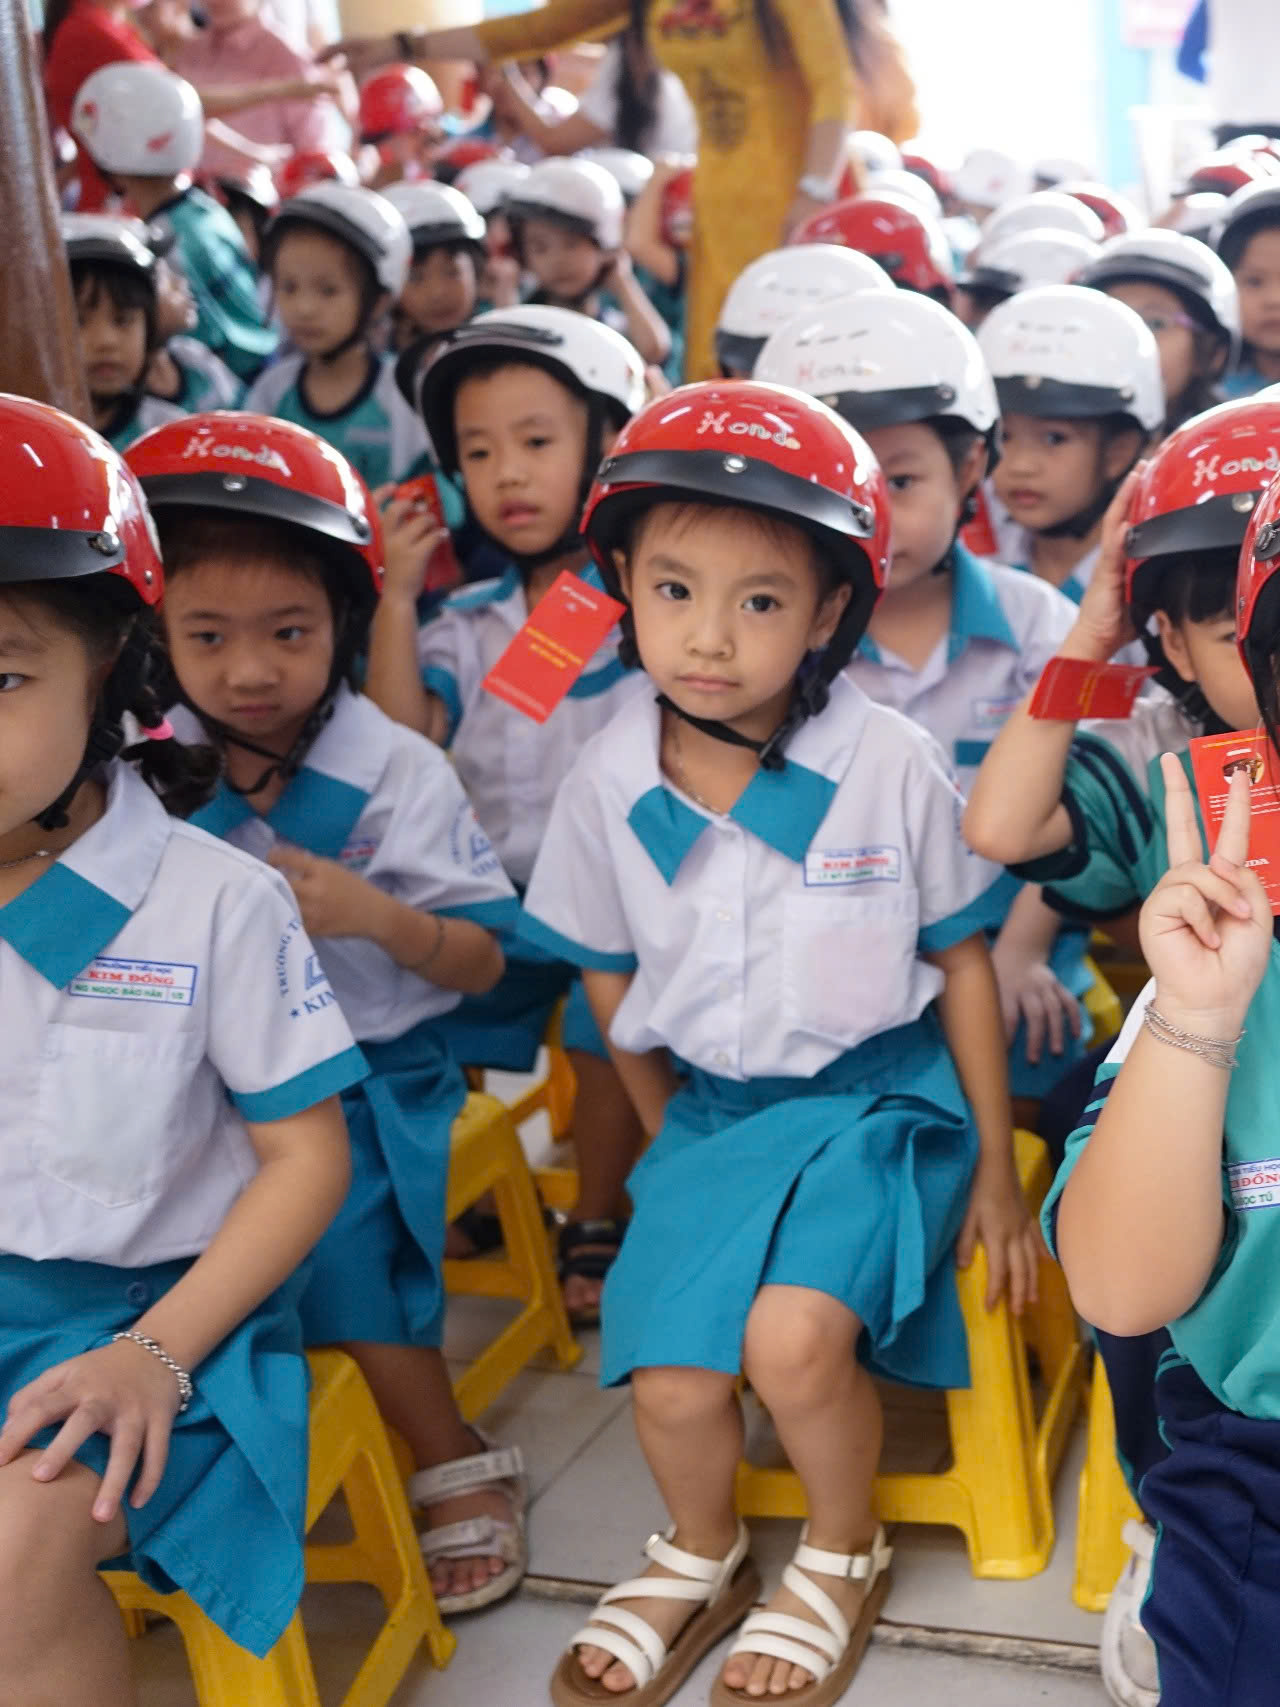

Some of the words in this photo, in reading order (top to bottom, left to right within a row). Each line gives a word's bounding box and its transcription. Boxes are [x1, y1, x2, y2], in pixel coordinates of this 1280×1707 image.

[697, 410, 801, 450] Honda
[182, 436, 284, 469] Honda
[88, 970, 123, 981] KIM
